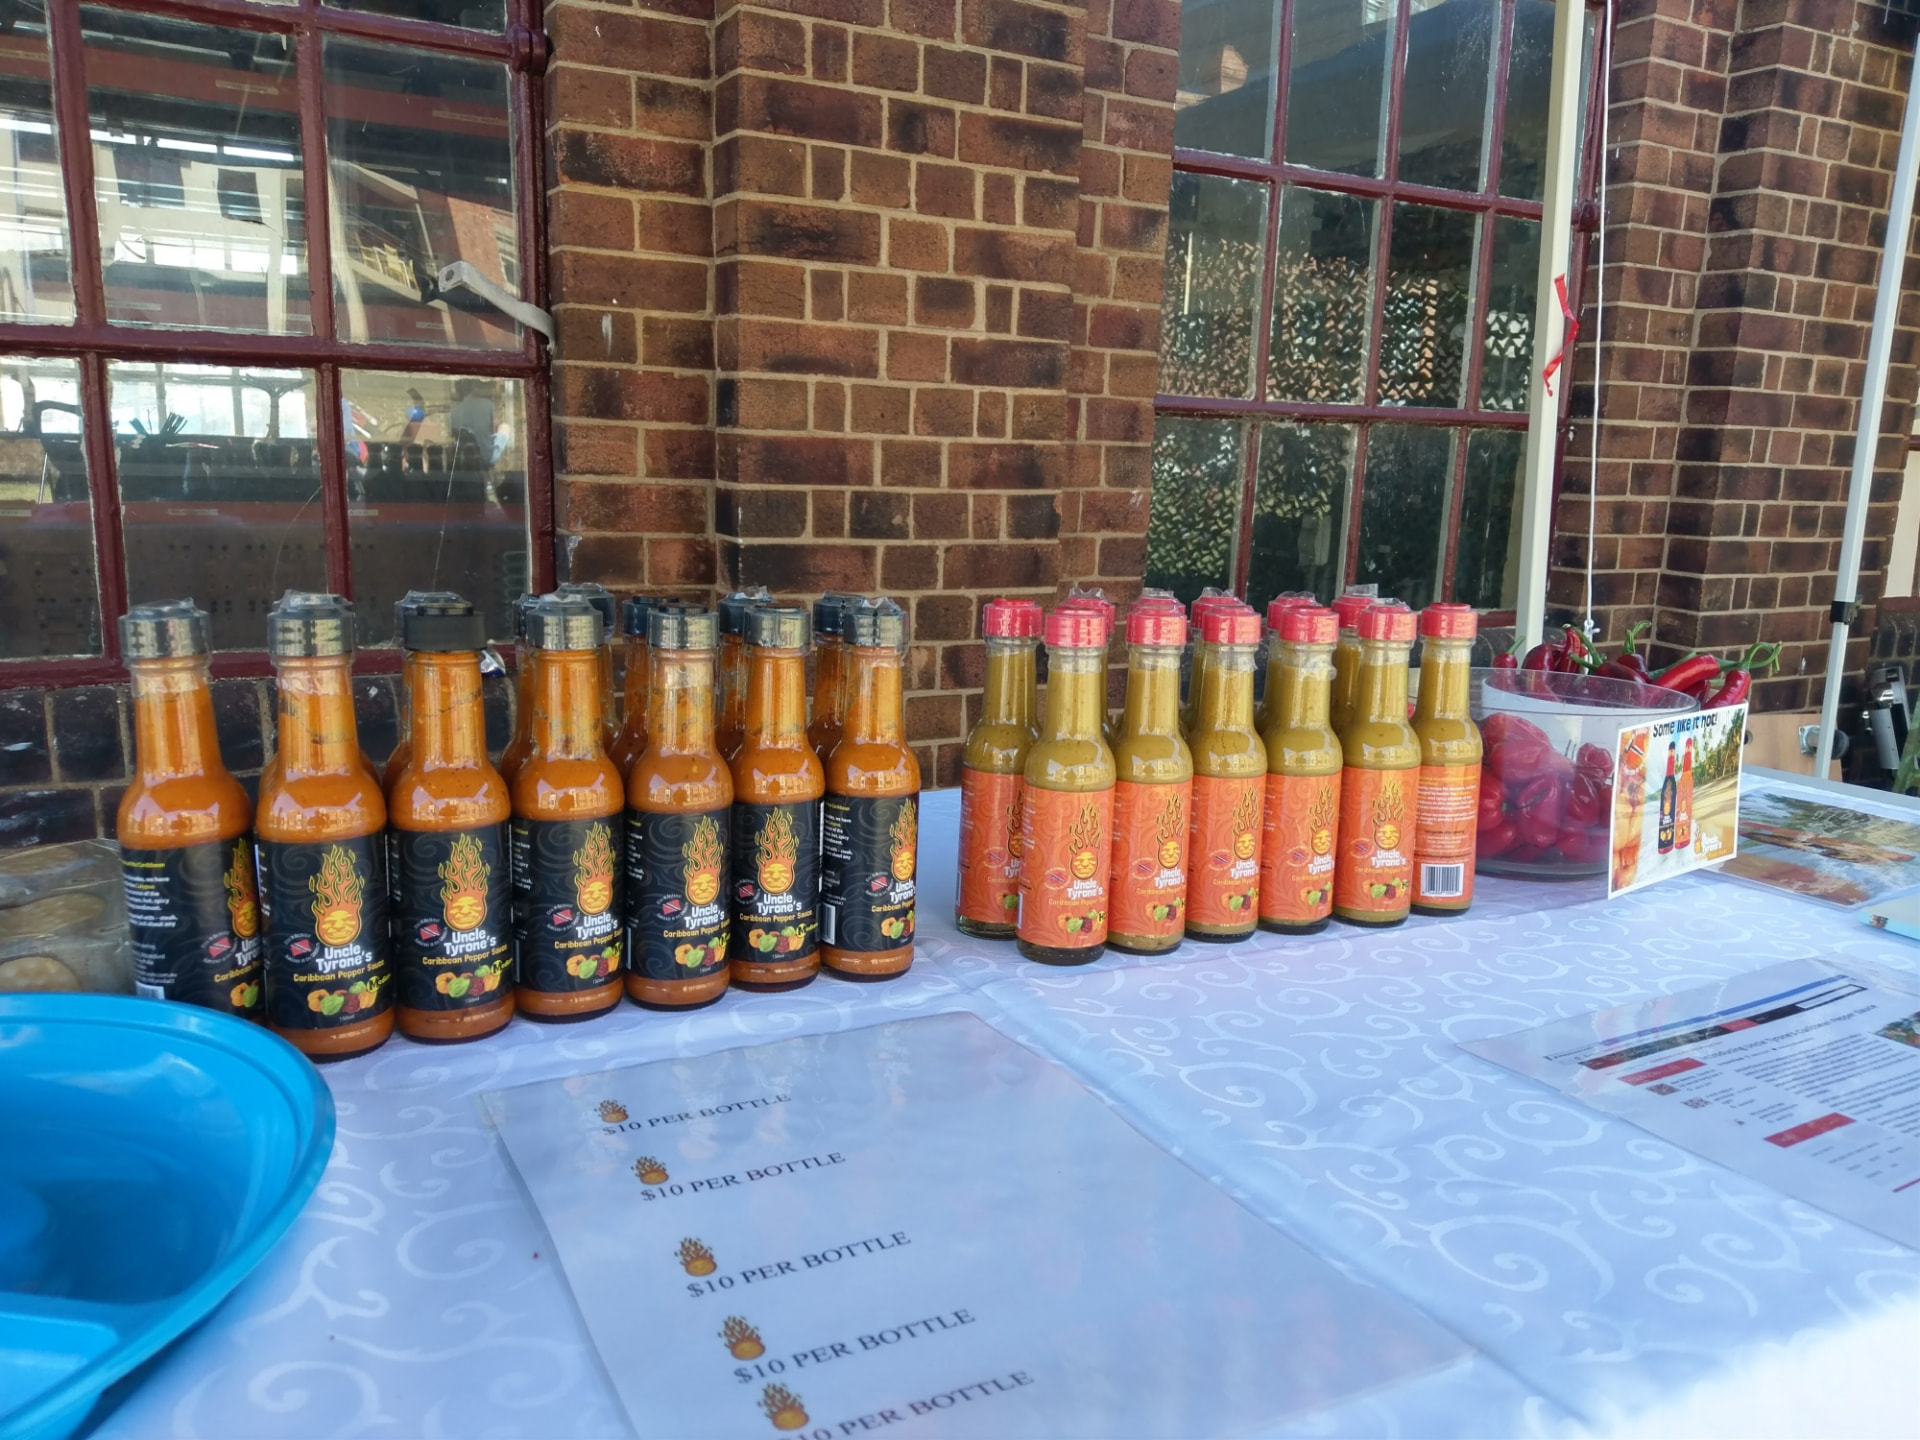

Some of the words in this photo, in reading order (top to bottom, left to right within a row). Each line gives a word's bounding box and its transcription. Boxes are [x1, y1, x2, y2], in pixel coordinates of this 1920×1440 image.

[1653, 721, 1675, 738] Some
[1676, 718, 1692, 733] like
[1377, 849, 1401, 859] Uncle
[1161, 866, 1181, 878] Uncle
[1074, 878, 1097, 889] Uncle
[763, 892, 793, 905] Uncle
[1067, 885, 1103, 900] Tyrone's
[691, 903, 718, 918] Uncle
[756, 900, 802, 916] Tyrone's
[583, 912, 611, 927] Uncle
[684, 909, 725, 930] Tyrone's
[739, 912, 772, 923] Caribbean
[772, 914, 796, 923] Pepper
[797, 910, 813, 919] Sauce
[452, 928, 486, 944] Uncle
[576, 919, 618, 940] Tyrone's
[663, 929, 699, 938] Caribbean
[701, 924, 720, 935] Pepper
[443, 936, 497, 957] Tyrone's
[554, 941, 592, 949] Caribbean
[593, 936, 613, 945] Pepper
[324, 944, 361, 960] Uncle
[422, 956, 463, 966] Caribbean
[464, 951, 490, 963] Pepper
[491, 944, 508, 955] Sauce
[316, 951, 373, 973] Tyrone's
[293, 973, 336, 983] Caribbean
[338, 967, 365, 979] Pepper
[367, 959, 385, 972] Sauce
[602, 1121, 641, 1136] $10
[648, 1112, 695, 1127] PER
[699, 1093, 791, 1117] BOTTLE
[640, 1184, 684, 1201] $10
[689, 1174, 741, 1193] PER
[746, 1152, 846, 1181] BOTTLE
[687, 1275, 734, 1298] $10
[740, 1260, 798, 1284] PER
[801, 1231, 911, 1268] BOTTLE
[733, 1359, 785, 1384] $10
[792, 1342, 854, 1368] PER
[857, 1308, 976, 1351] BOTTLE
[777, 1427, 831, 1440] 10
[839, 1409, 904, 1436] PER
[908, 1371, 1034, 1415] BOTTLE
